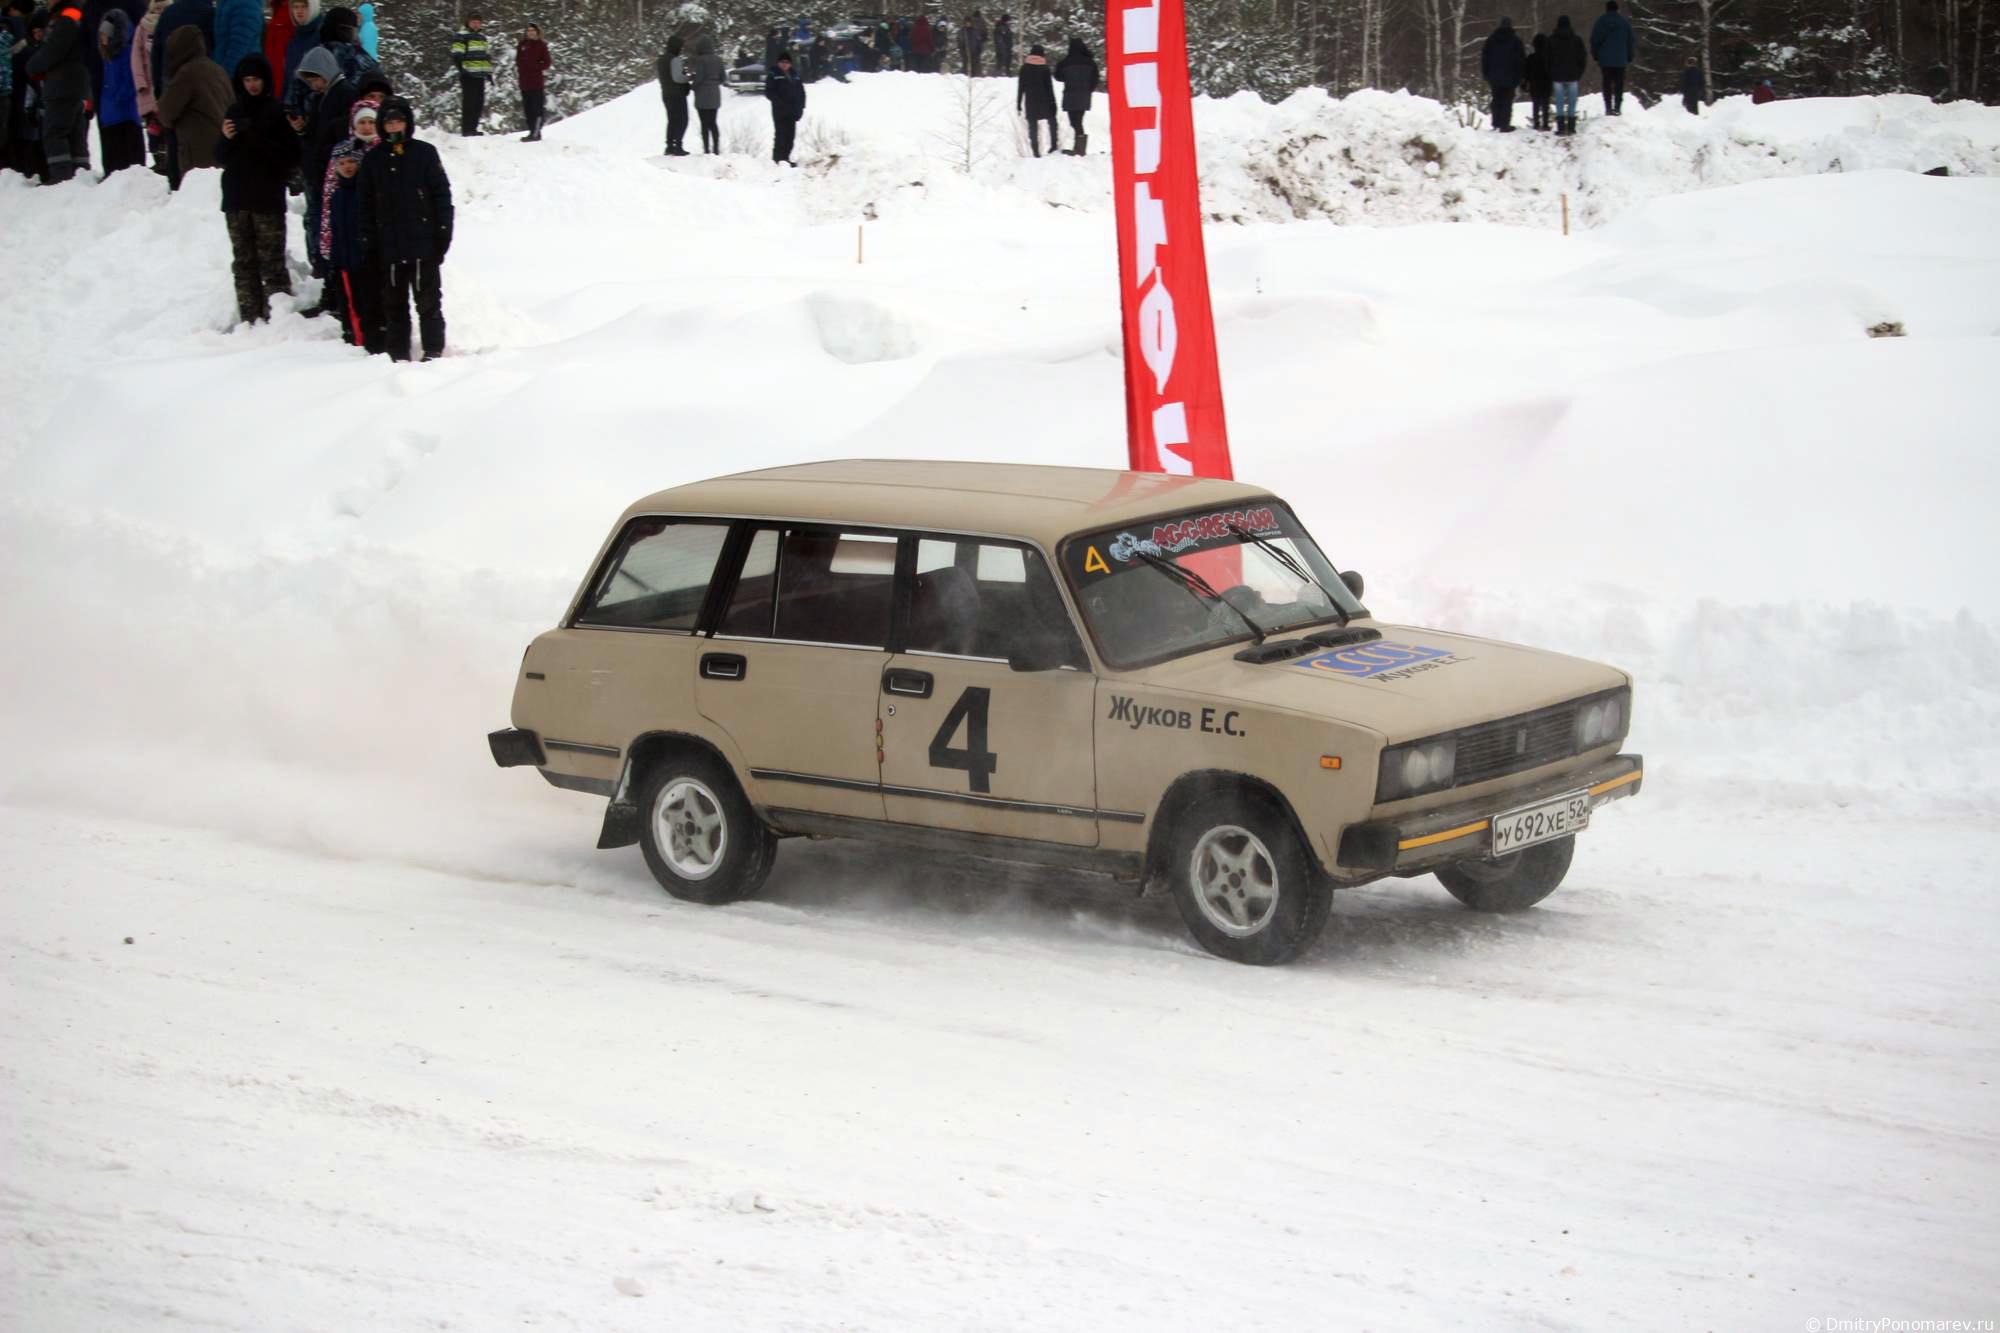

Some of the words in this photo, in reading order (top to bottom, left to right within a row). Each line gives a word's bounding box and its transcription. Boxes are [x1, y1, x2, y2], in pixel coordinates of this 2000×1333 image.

[1085, 546, 1111, 574] 4
[1108, 696, 1191, 729] Жуков
[1200, 707, 1245, 736] Е.С.
[928, 686, 997, 793] 4
[1569, 800, 1584, 819] 52
